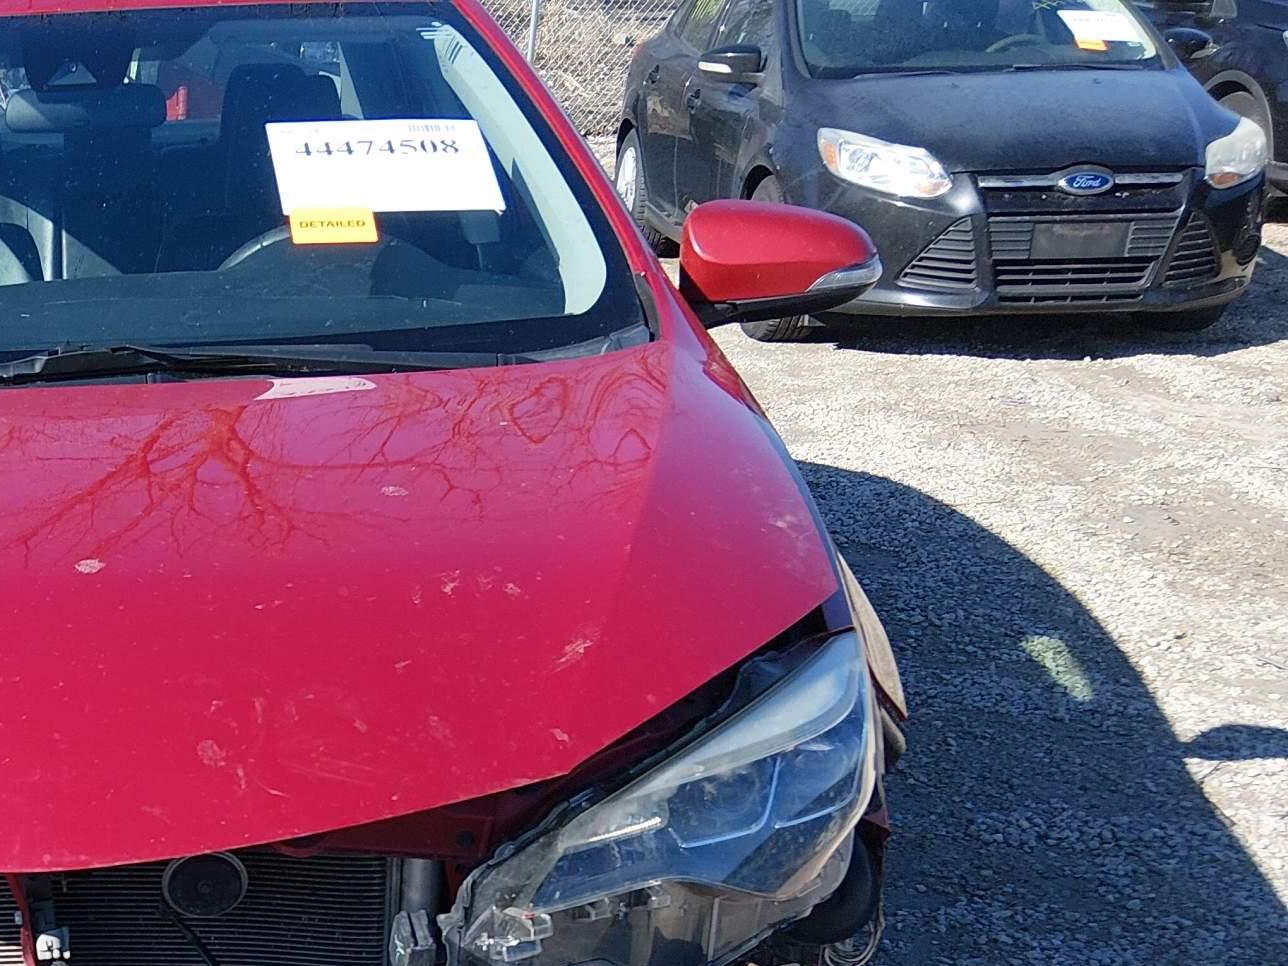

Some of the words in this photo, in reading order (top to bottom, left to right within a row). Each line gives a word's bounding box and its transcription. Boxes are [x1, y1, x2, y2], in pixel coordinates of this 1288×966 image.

[295, 139, 460, 156] 44474508
[1072, 175, 1102, 188] Ford
[299, 219, 366, 229] DETAILED
